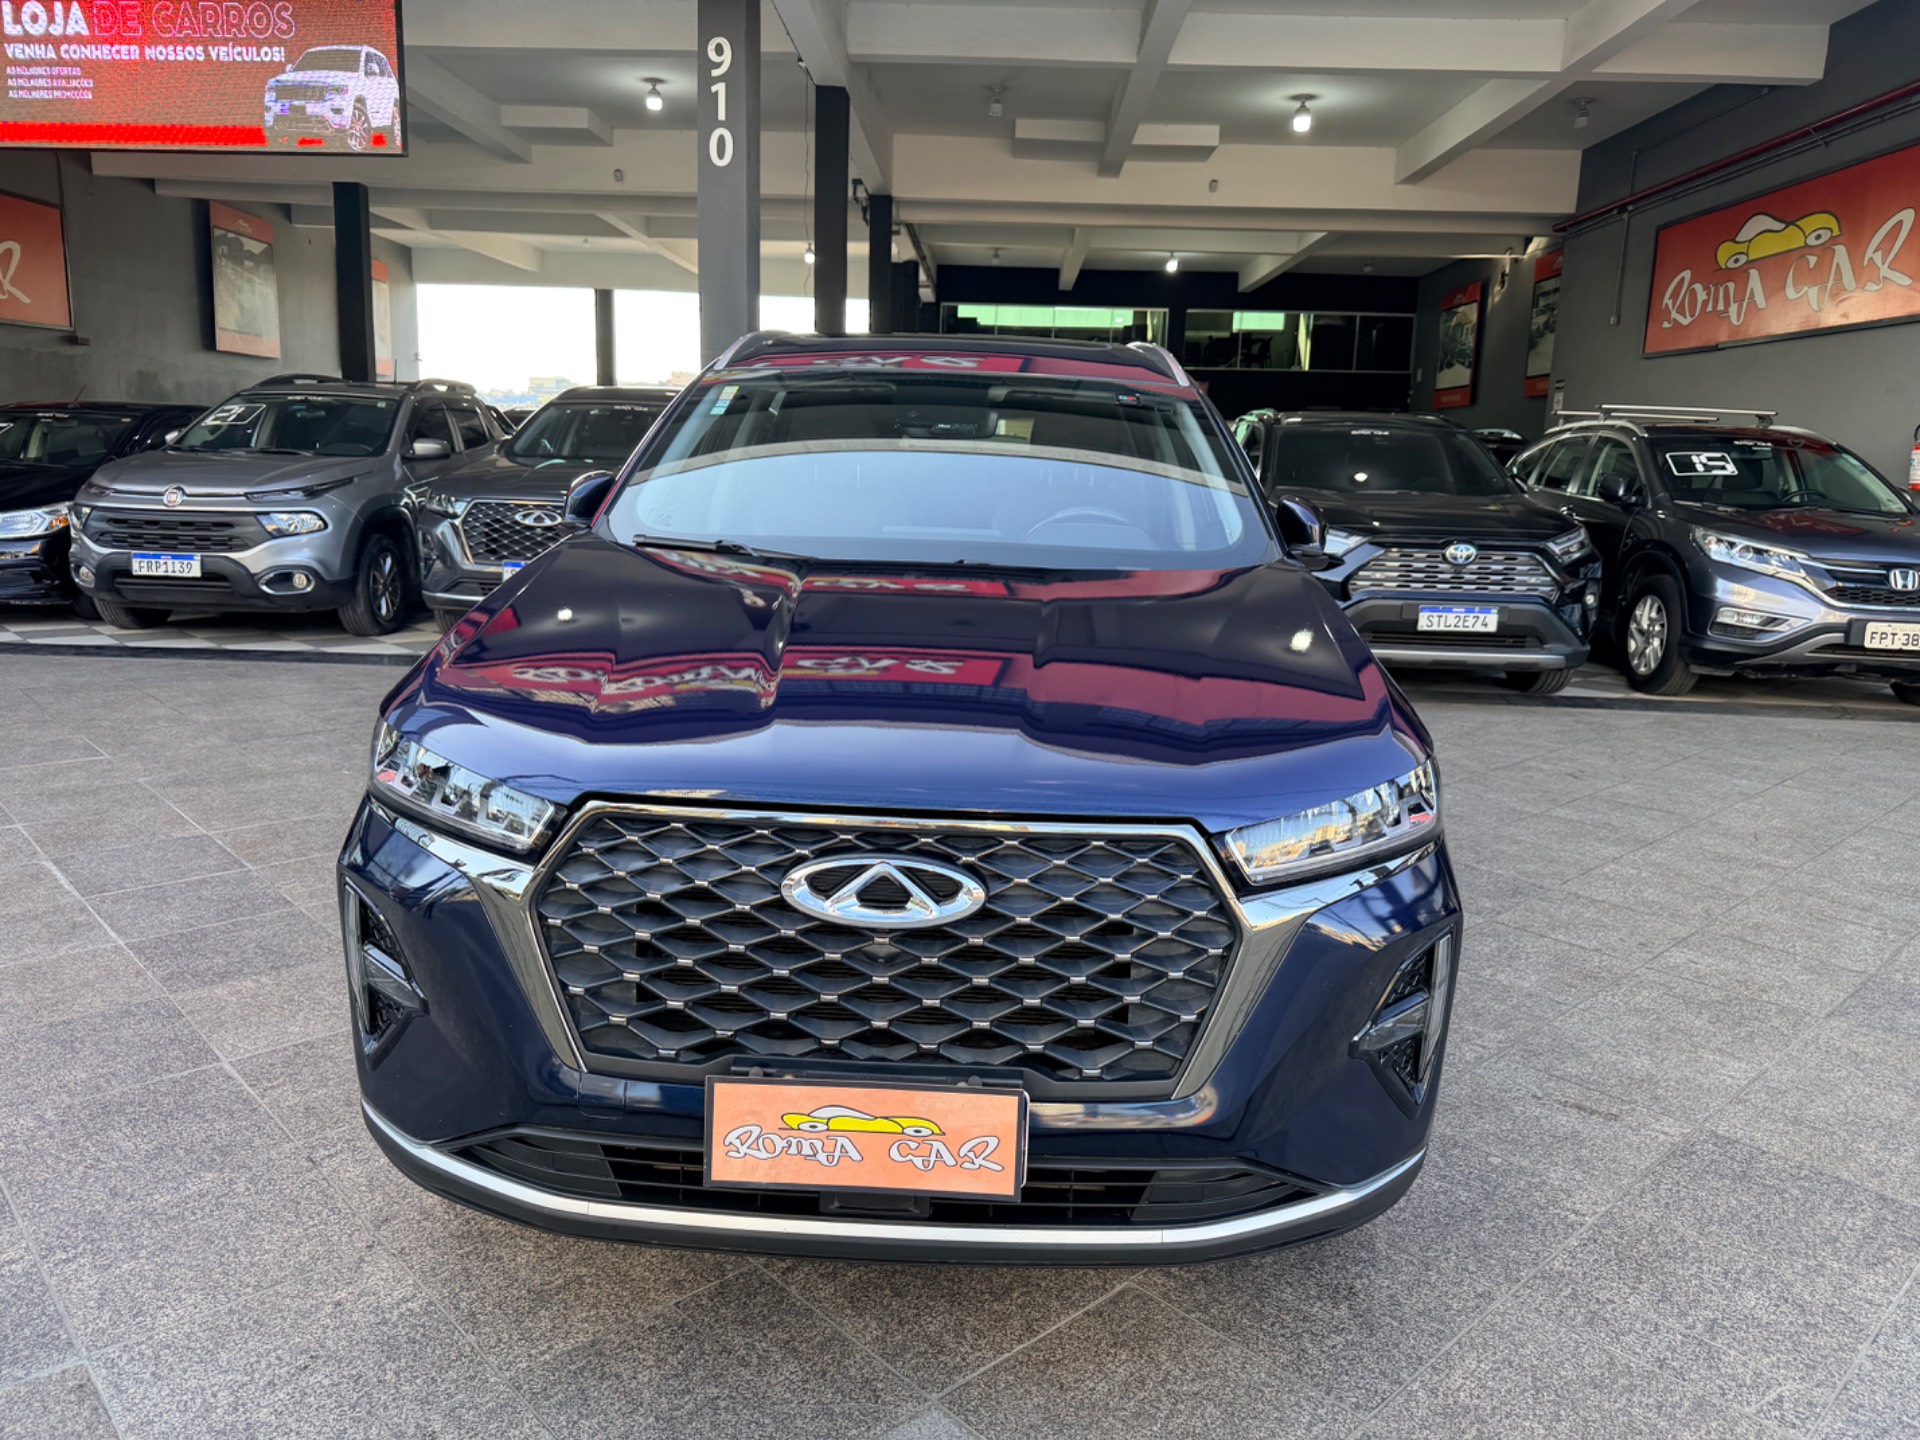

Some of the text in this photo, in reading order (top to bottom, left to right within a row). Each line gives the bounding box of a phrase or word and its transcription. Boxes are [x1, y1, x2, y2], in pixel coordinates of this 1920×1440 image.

[2, 0, 296, 38] LOJA DE CARROS
[4, 42, 286, 62] VENHA CONHECER NOSSOS VEÍCULOS!
[707, 36, 734, 167] 910
[1425, 613, 1489, 629] STL2E74
